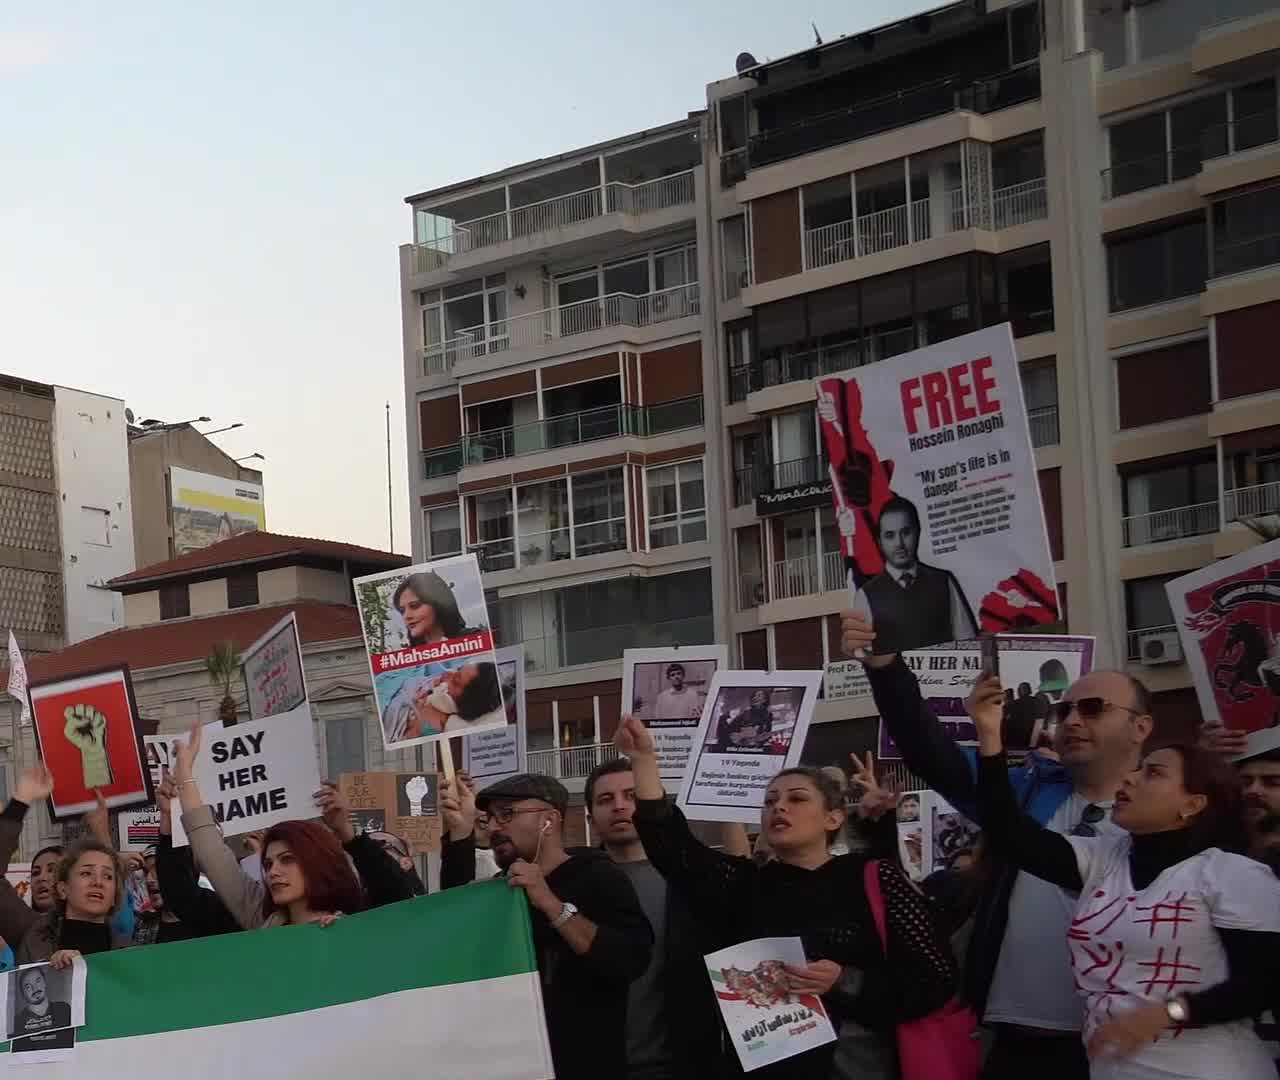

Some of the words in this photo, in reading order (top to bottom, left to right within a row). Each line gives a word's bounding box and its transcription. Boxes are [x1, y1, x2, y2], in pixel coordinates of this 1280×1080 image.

[901, 356, 1001, 434] FREE
[909, 427, 954, 452] Hossein
[957, 413, 1004, 439] Ronaghi
[938, 462, 966, 479] son's
[968, 456, 985, 471] life
[987, 453, 997, 466] is
[999, 449, 1010, 462] in
[379, 635, 483, 669] #MahsaAmini
[930, 656, 957, 670] HER
[963, 656, 983, 670] NA
[211, 731, 265, 763] SAY
[219, 764, 268, 791] HER
